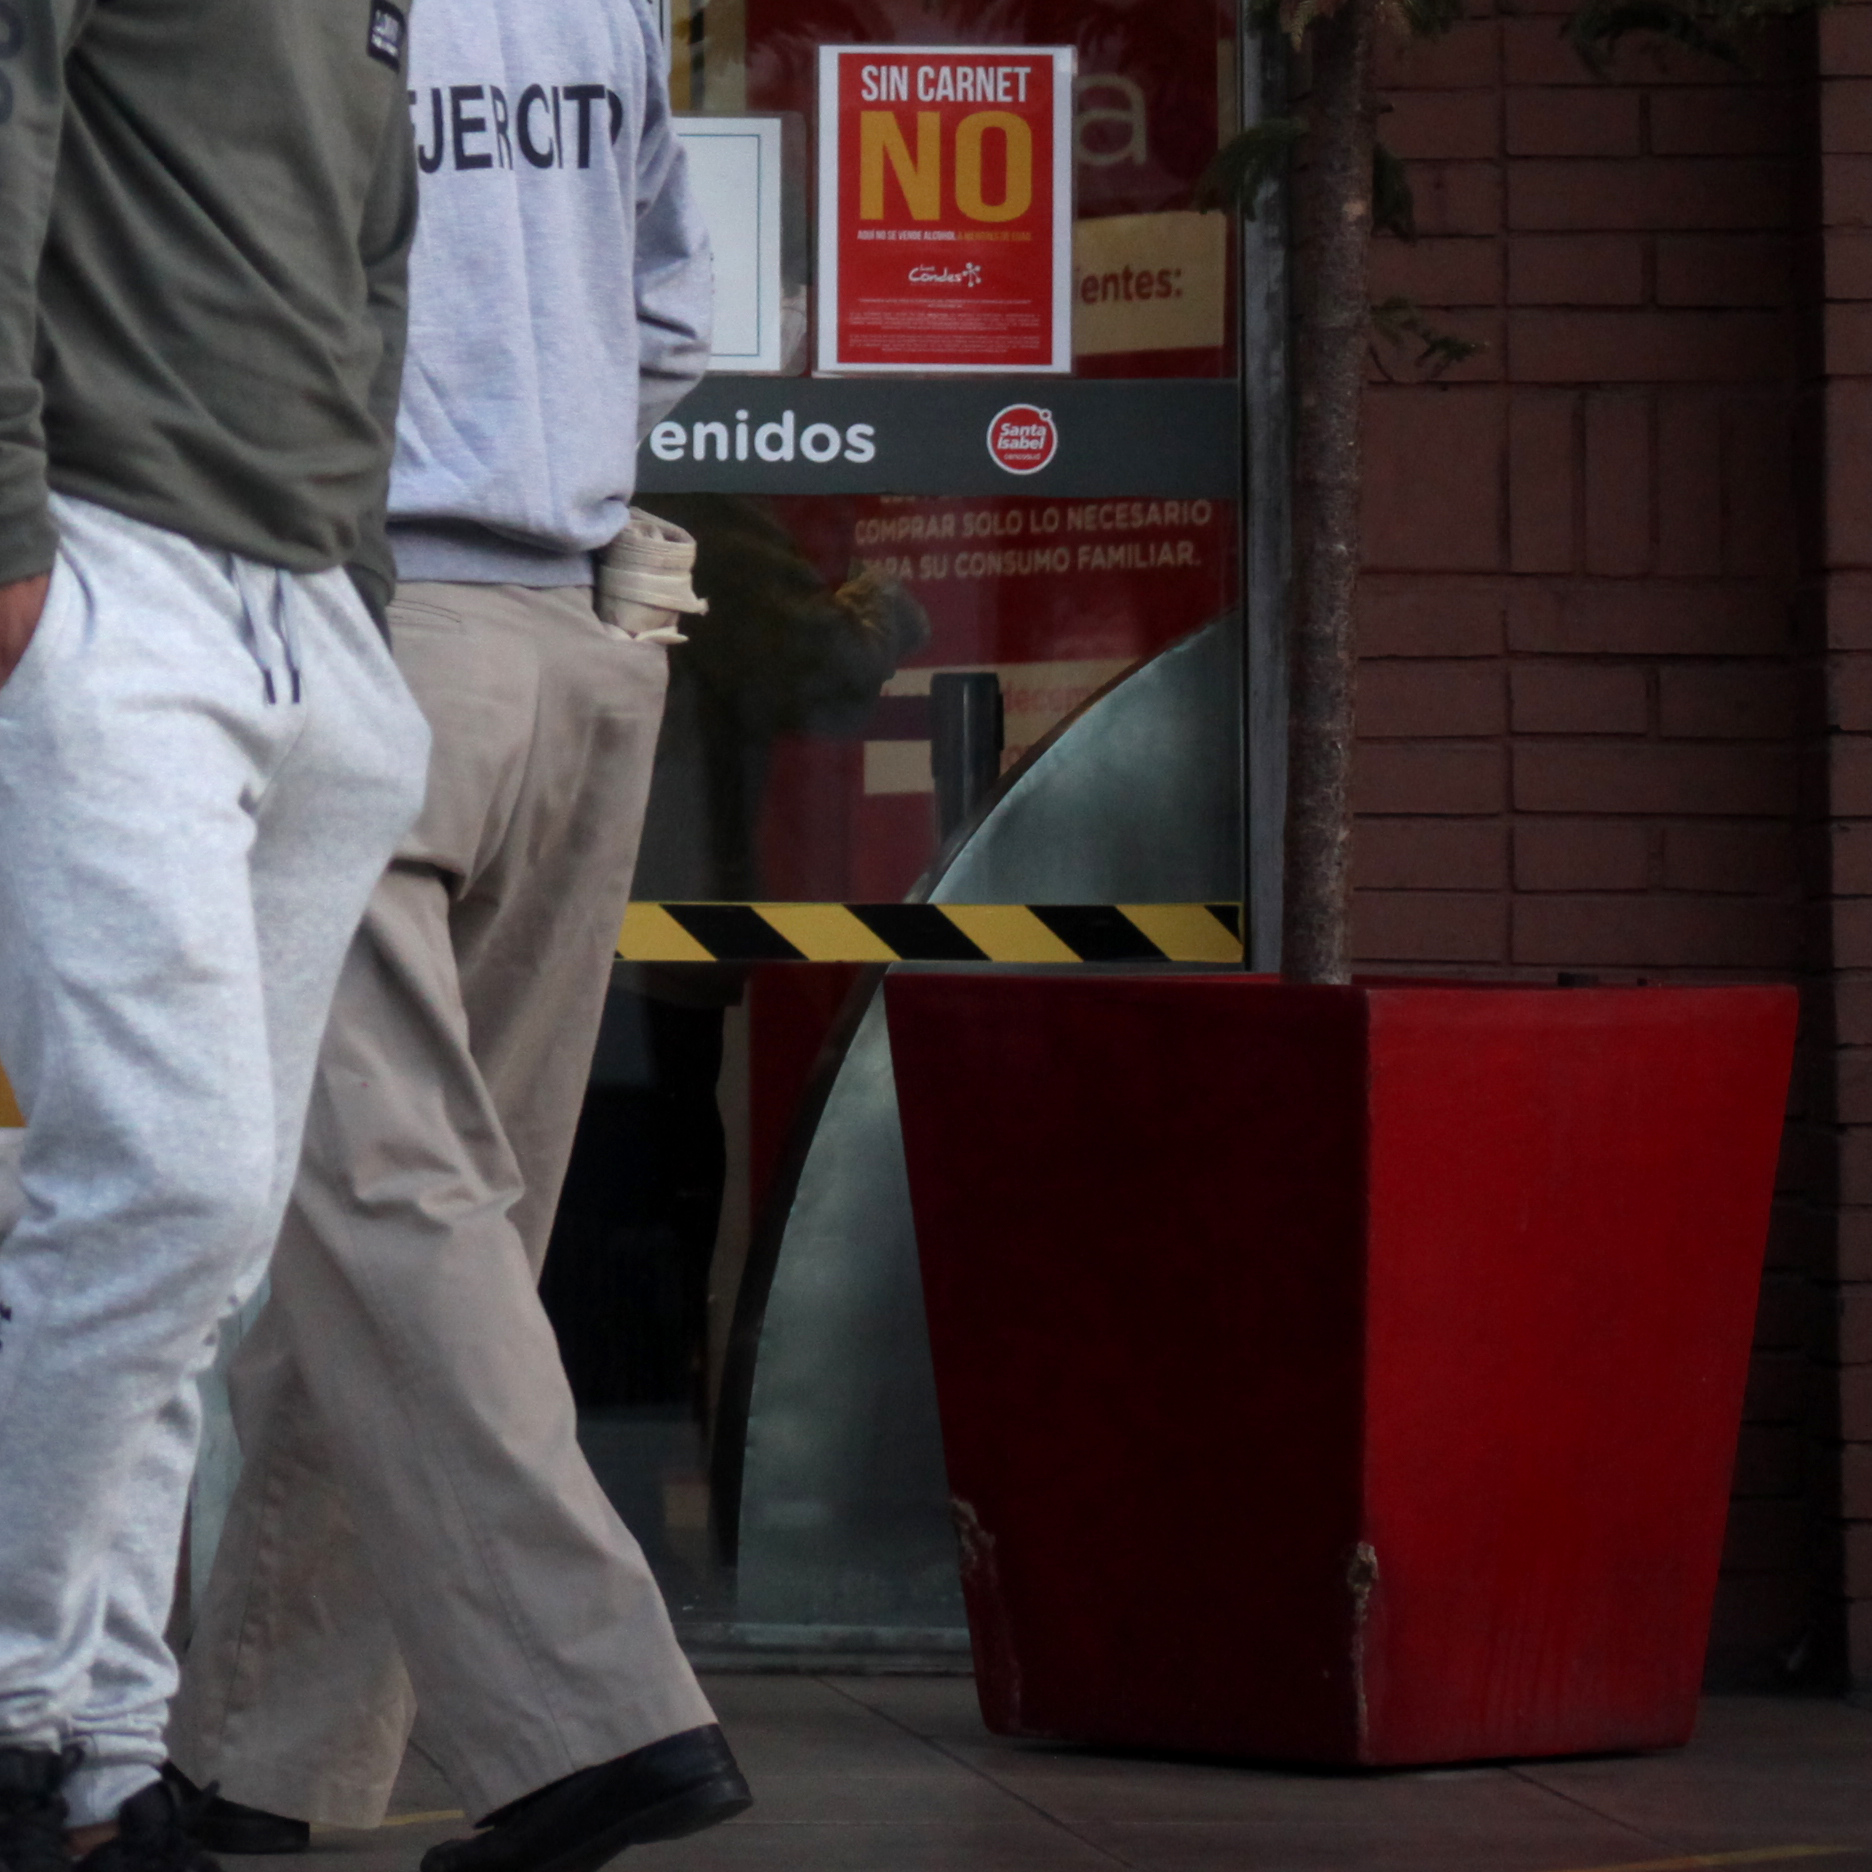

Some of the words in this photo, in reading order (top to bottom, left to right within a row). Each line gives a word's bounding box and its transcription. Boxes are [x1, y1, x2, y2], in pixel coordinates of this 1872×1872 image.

[861, 65, 909, 102] SIN
[916, 66, 1032, 103] CARNET
[407, 83, 623, 174] JERCIT
[859, 111, 1032, 223] NO
[907, 267, 962, 283] Condes
[649, 409, 876, 463] enidos
[997, 436, 1045, 450] Isabel
[1000, 423, 1047, 437] Santa
[856, 514, 955, 545] COMPRAR
[961, 510, 1022, 538] SOLO
[1029, 507, 1059, 534] LO
[1067, 499, 1212, 533] NECESARIO
[920, 552, 947, 579] SU
[955, 547, 1070, 577] CONSUMO
